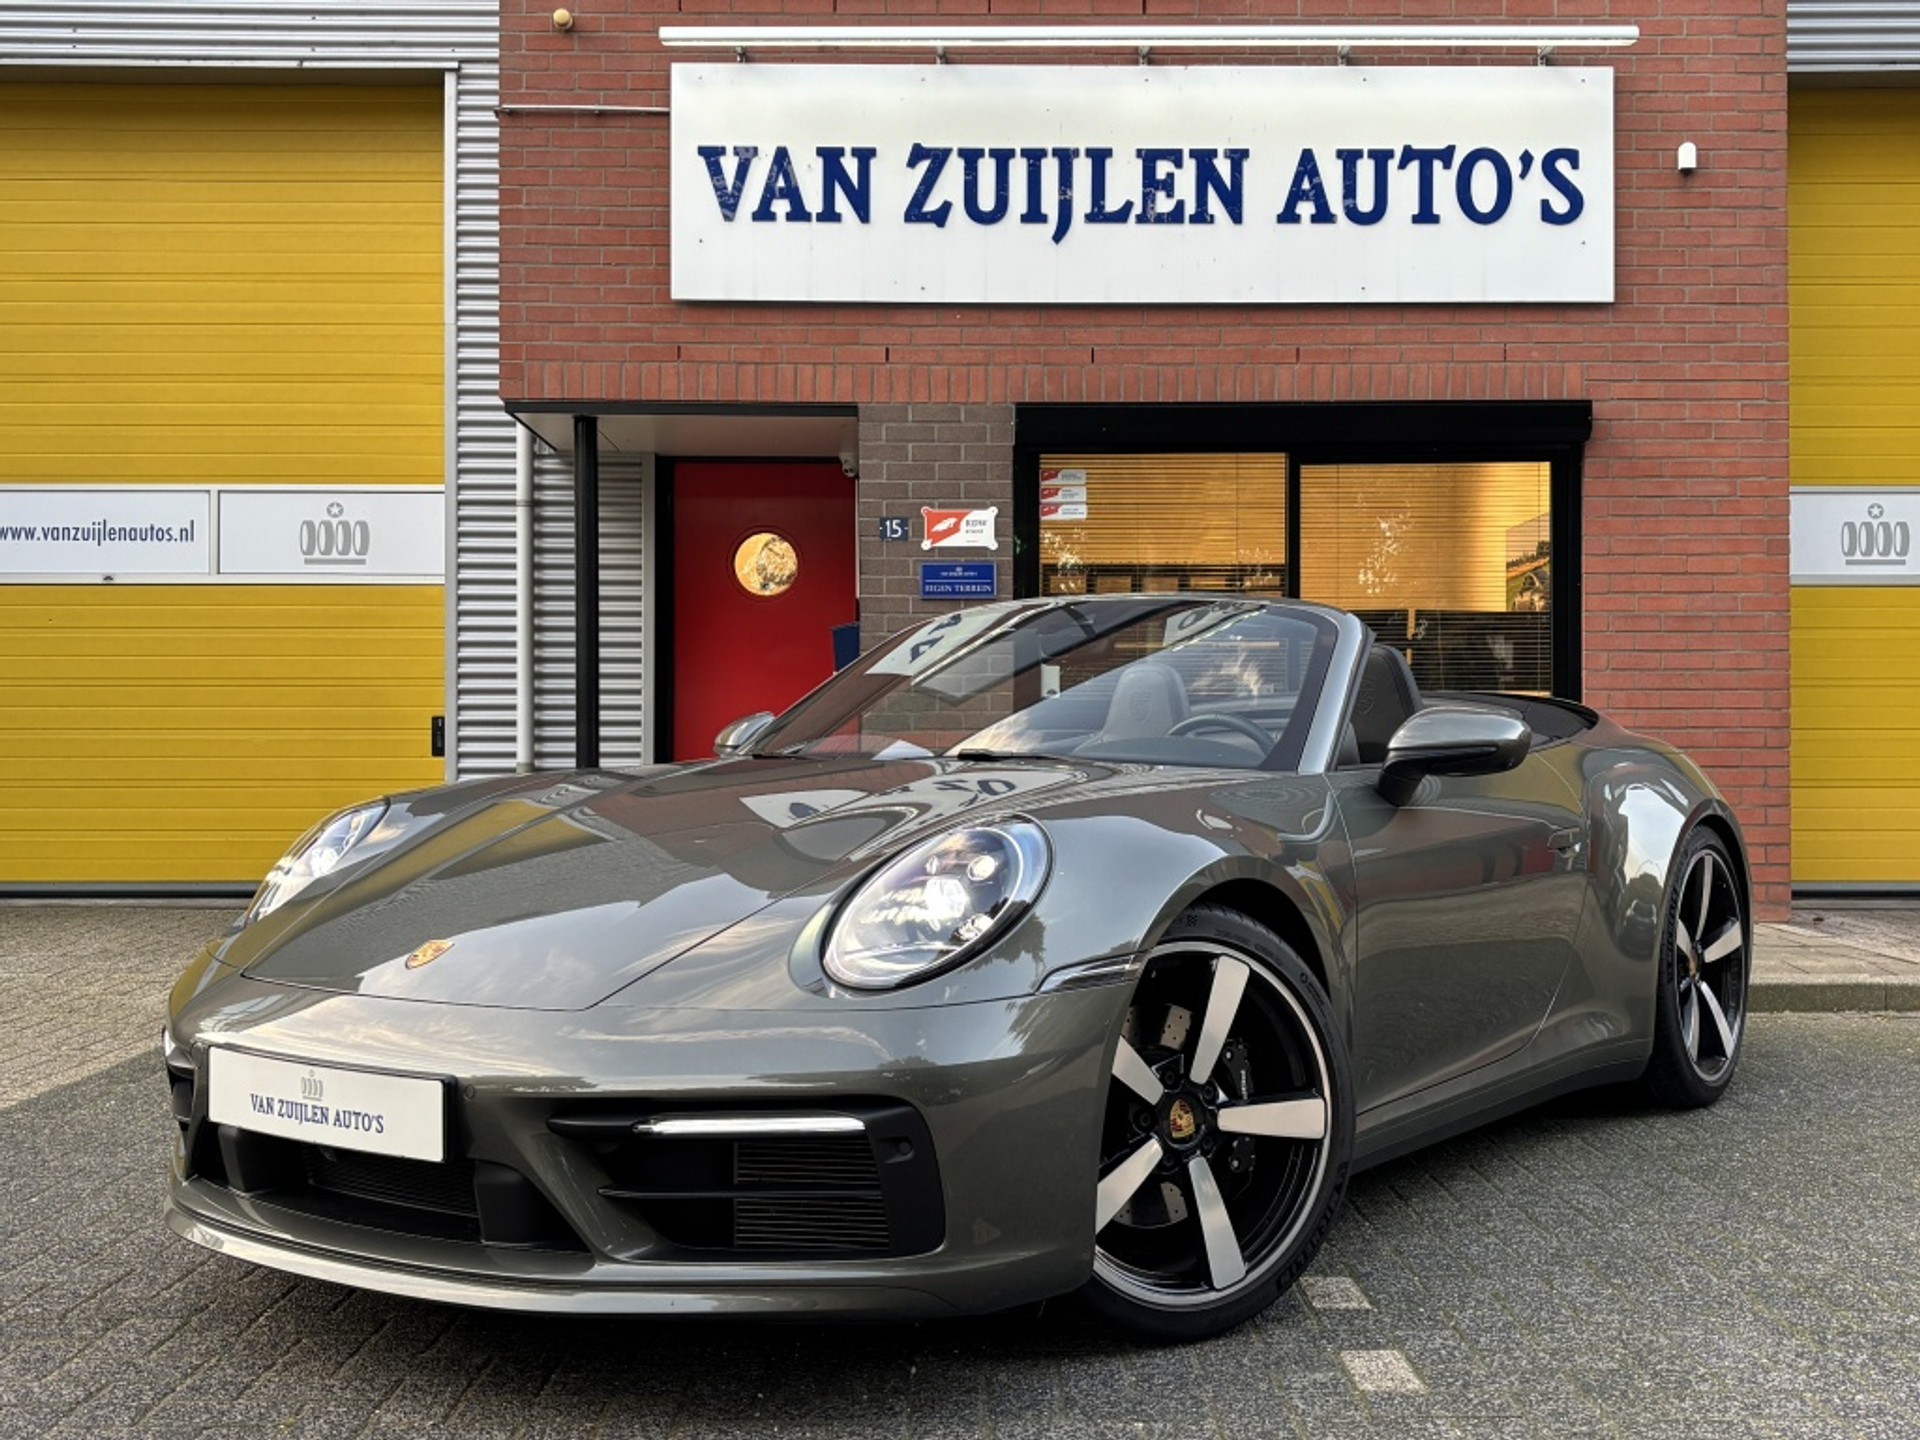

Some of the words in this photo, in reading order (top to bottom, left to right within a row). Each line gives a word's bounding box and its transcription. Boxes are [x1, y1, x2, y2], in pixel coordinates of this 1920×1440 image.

[697, 146, 877, 224] VAN
[903, 142, 1250, 245] ZUIJLEN
[1276, 144, 1584, 226] AUTO'S
[0, 519, 195, 547] www.vanzuijlenautos.nl
[884, 519, 903, 538] 15
[250, 1093, 275, 1115] VAN
[277, 1098, 329, 1126] ZUIJLEN
[333, 1109, 384, 1134] AUTO'S
